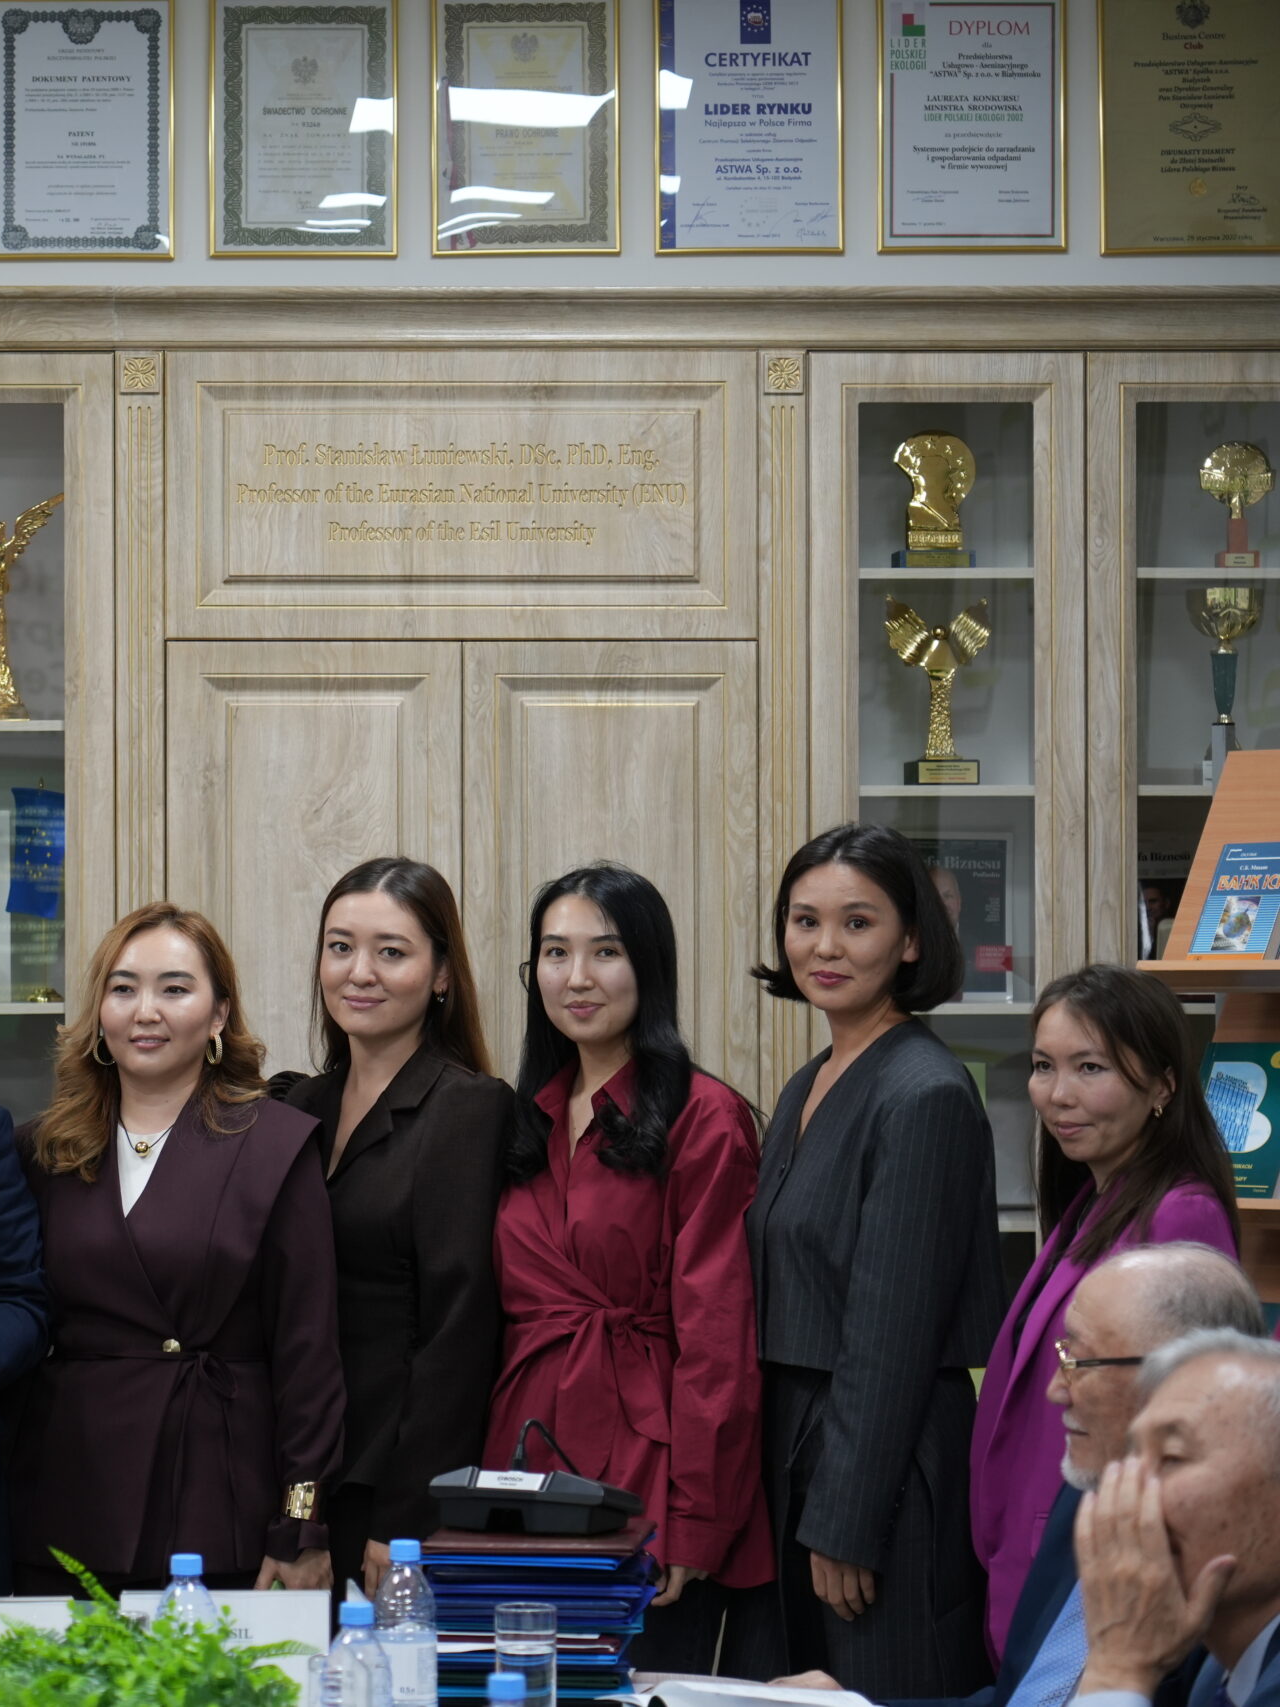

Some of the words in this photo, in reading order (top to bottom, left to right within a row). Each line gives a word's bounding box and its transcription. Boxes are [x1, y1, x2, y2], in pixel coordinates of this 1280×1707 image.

[949, 20, 1030, 35] DYPLOM
[890, 39, 926, 48] LIDER
[704, 52, 812, 67] CERTYFIKAT
[890, 50, 927, 59] POLSKIEJ
[890, 60, 927, 70] EKOLOGII
[31, 75, 78, 83] DOKUMENT
[82, 75, 131, 83] PATENTOWY
[262, 106, 306, 116] ŚWIADECTWO
[311, 107, 347, 116] OCHRONNE
[704, 103, 751, 116] LIDER
[756, 103, 812, 115] RYNKU
[924, 113, 942, 122] LIDER
[944, 113, 973, 122] POLSKIEJ
[974, 113, 1005, 122] EKOLOGII
[704, 119, 746, 129] Najlepsza
[760, 119, 785, 127] Polsce
[788, 119, 812, 127] Firma
[913, 145, 949, 155] Systemowe
[715, 165, 753, 174] ASTWA
[756, 165, 771, 176] Sp.
[947, 162, 969, 170] firmie
[263, 443, 309, 465] Prof.
[314, 442, 407, 465] Stanisław
[410, 442, 515, 468] Łuniewski,
[519, 444, 562, 468] DSc,
[567, 444, 613, 468] PhD,
[618, 444, 660, 471] Eng.
[236, 483, 320, 504] Professor
[324, 483, 346, 504] of
[345, 483, 374, 504] the
[378, 483, 455, 504] Eurasian
[459, 483, 533, 504] National
[537, 483, 628, 508] University
[631, 483, 688, 507] (ENU)
[328, 521, 411, 543] Professor
[416, 521, 436, 543] of
[436, 521, 466, 543] the
[469, 521, 502, 543] Esil
[506, 521, 597, 545] University
[944, 855, 1001, 870] Biznesu
[1216, 874, 1262, 891] БАНК
[228, 1627, 253, 1639] SIL
